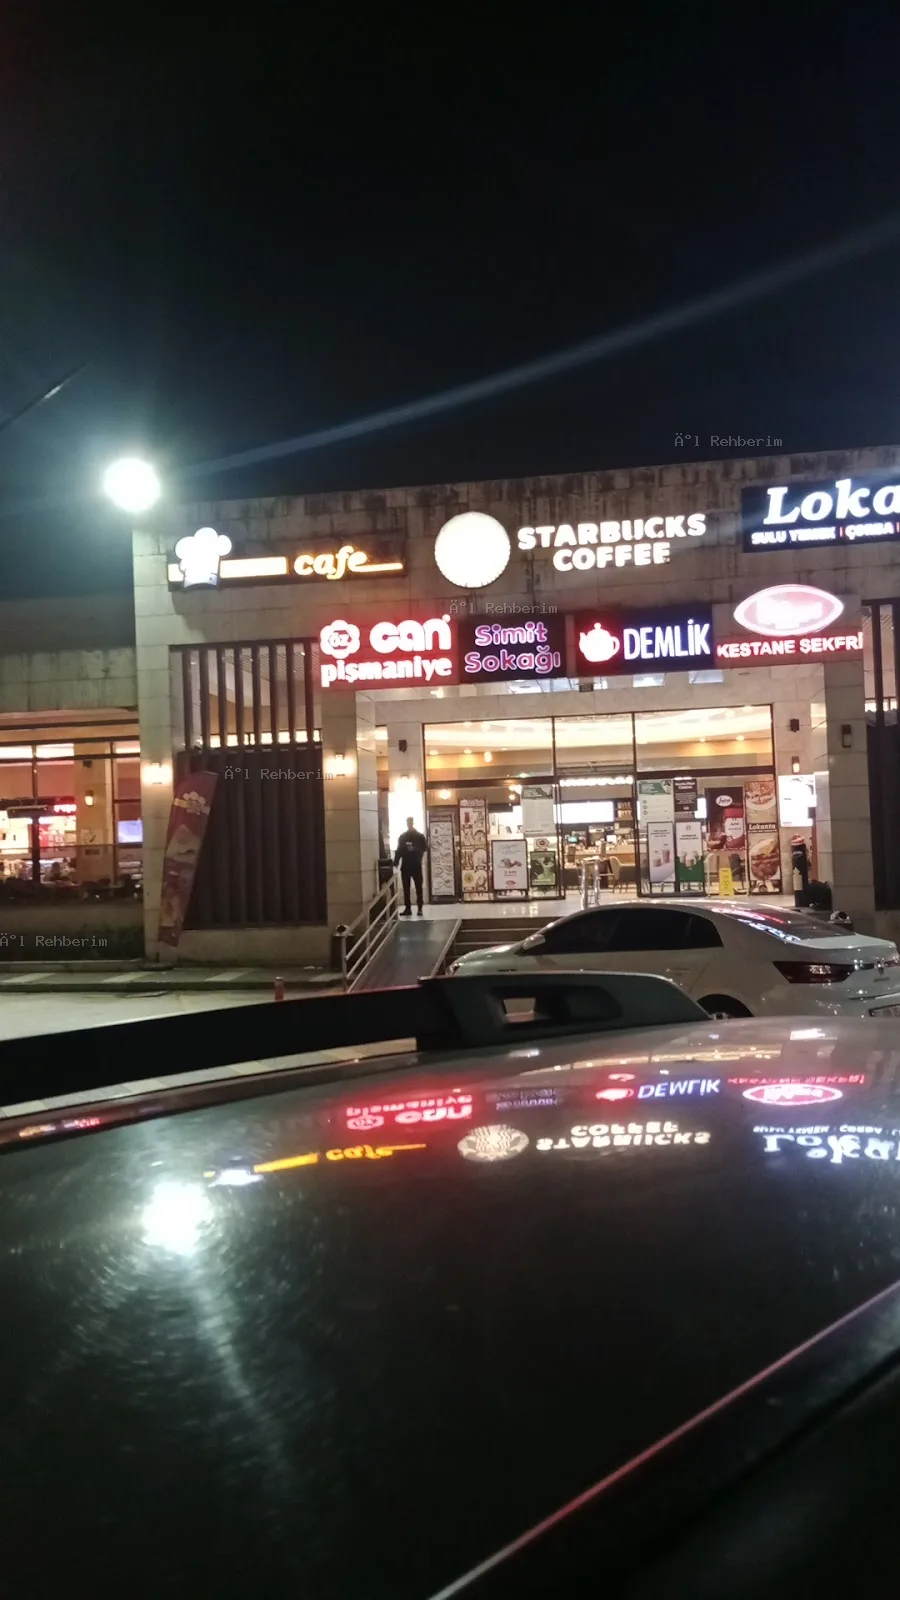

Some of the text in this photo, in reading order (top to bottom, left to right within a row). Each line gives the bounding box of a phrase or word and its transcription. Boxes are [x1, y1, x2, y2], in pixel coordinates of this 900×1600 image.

[517, 513, 707, 551] STARBUCKS
[293, 545, 402, 580] cafe
[552, 541, 671, 572] COFFEE
[369, 616, 452, 654] can
[474, 620, 548, 647] Simit
[623, 618, 711, 661] DEMLİK
[716, 639, 796, 659] KESTANE
[320, 654, 453, 688] pişmaniye
[464, 645, 561, 674] Sokağı
